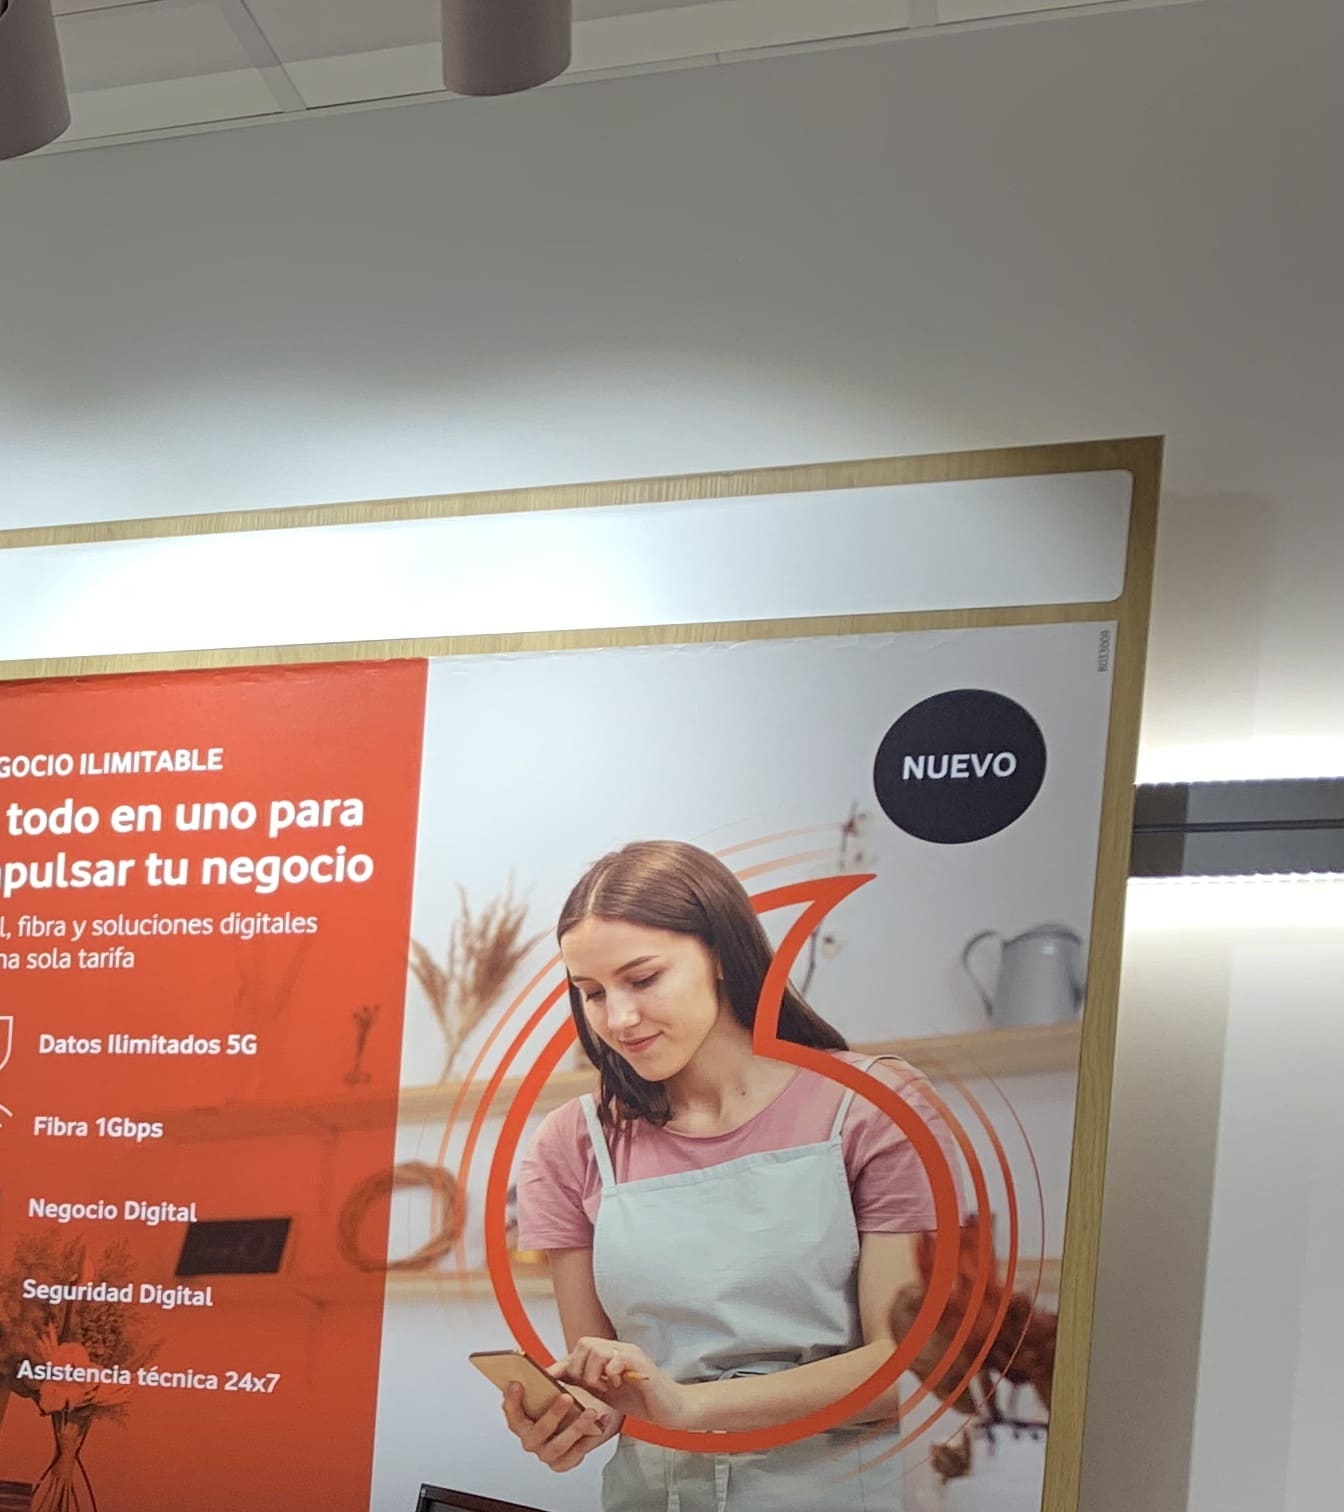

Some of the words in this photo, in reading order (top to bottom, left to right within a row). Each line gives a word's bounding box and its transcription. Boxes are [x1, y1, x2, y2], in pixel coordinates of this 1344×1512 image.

[79, 748, 224, 776] ILIMITABLE
[902, 752, 1016, 780] NUEVO
[6, 799, 100, 836] todo
[111, 806, 162, 833] en
[175, 802, 257, 832] uno
[269, 797, 365, 838] para
[145, 853, 189, 887] tu
[201, 845, 374, 893] negocio
[17, 914, 66, 937] fibra
[71, 921, 87, 941] y
[92, 913, 213, 936] soluciones
[219, 911, 318, 940] digitales
[26, 947, 72, 968] sola
[78, 945, 135, 968] tarifa
[39, 1034, 102, 1055] Datos
[107, 1034, 222, 1056] Ilimitados
[227, 1034, 258, 1055] 5G
[33, 1117, 88, 1137] Fibra
[95, 1117, 164, 1141] 1Gbps
[28, 1199, 118, 1223] Negocio
[124, 1200, 198, 1225] Digital
[22, 1279, 134, 1305] Seguridad
[140, 1282, 214, 1307] Digital
[16, 1360, 132, 1387] Asistencia
[137, 1363, 218, 1391] técnica
[225, 1371, 280, 1394] 24x7
